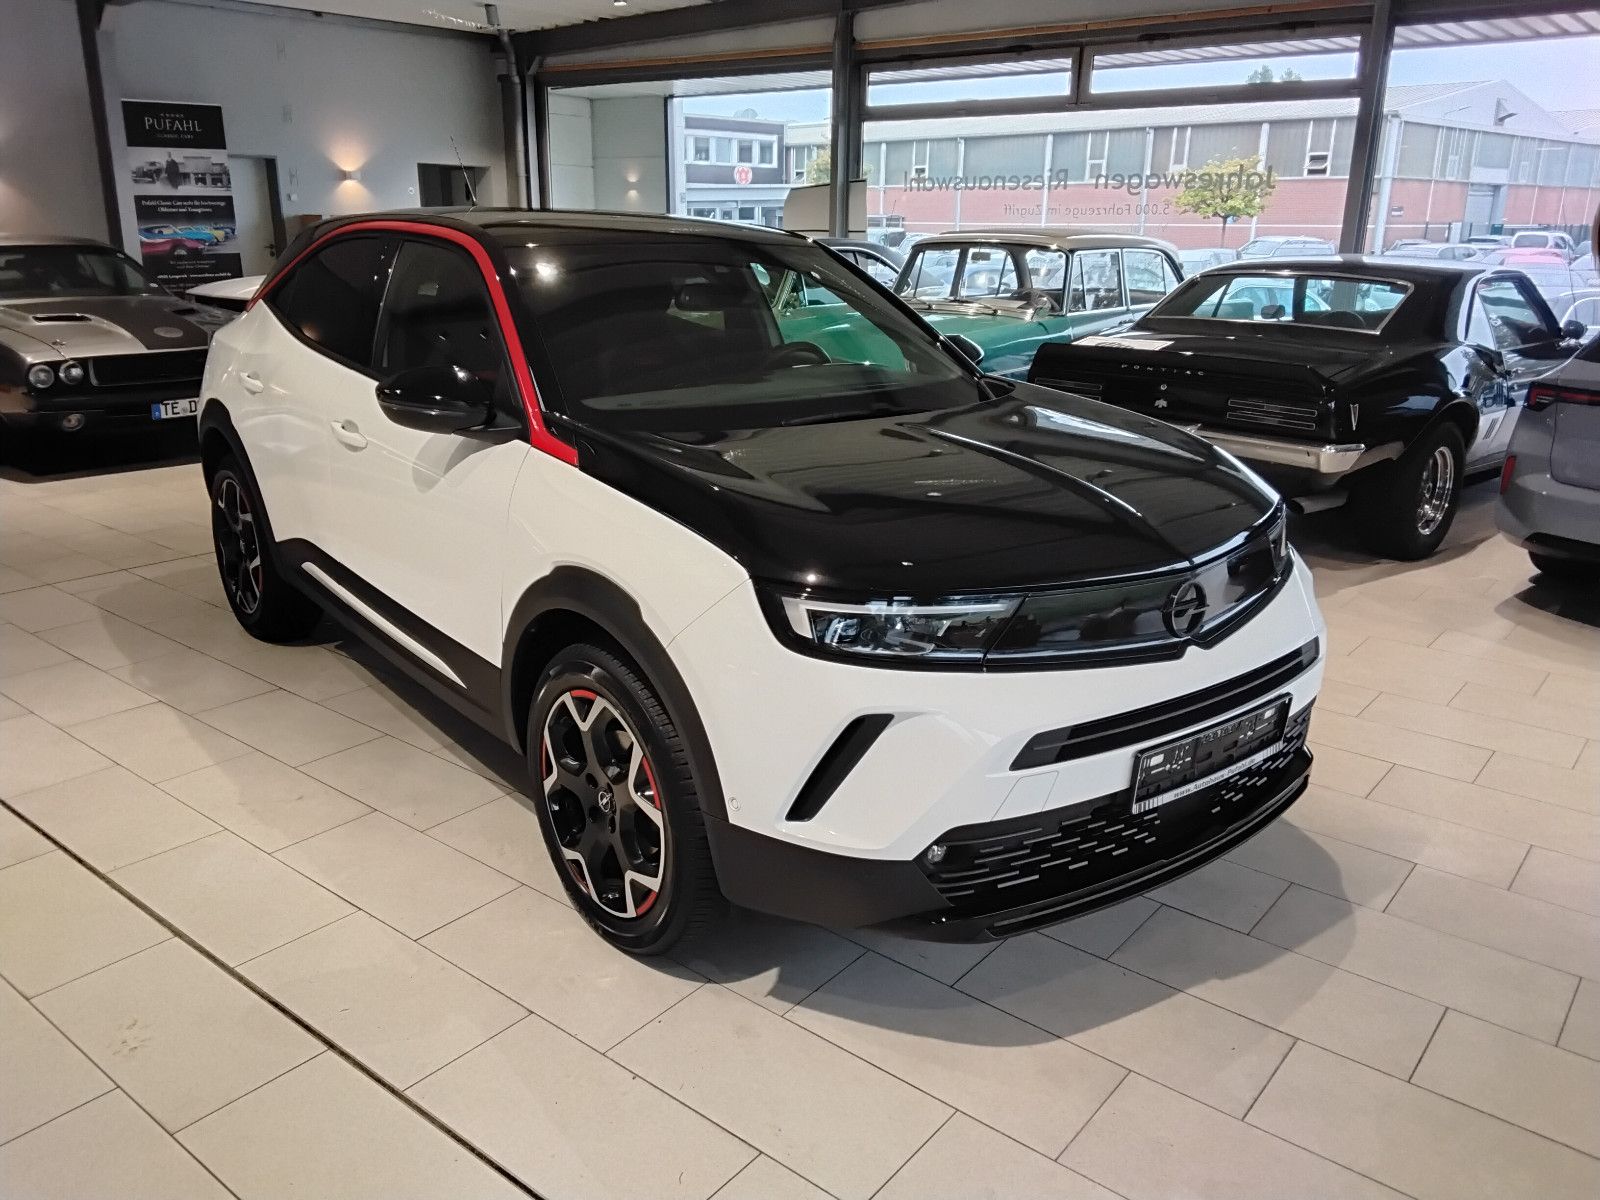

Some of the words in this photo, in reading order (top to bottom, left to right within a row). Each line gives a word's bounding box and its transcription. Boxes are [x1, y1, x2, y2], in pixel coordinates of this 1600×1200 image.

[144, 116, 202, 132] PUFAHL
[1121, 363, 1204, 376] PONTIAC
[162, 402, 180, 416] TE
